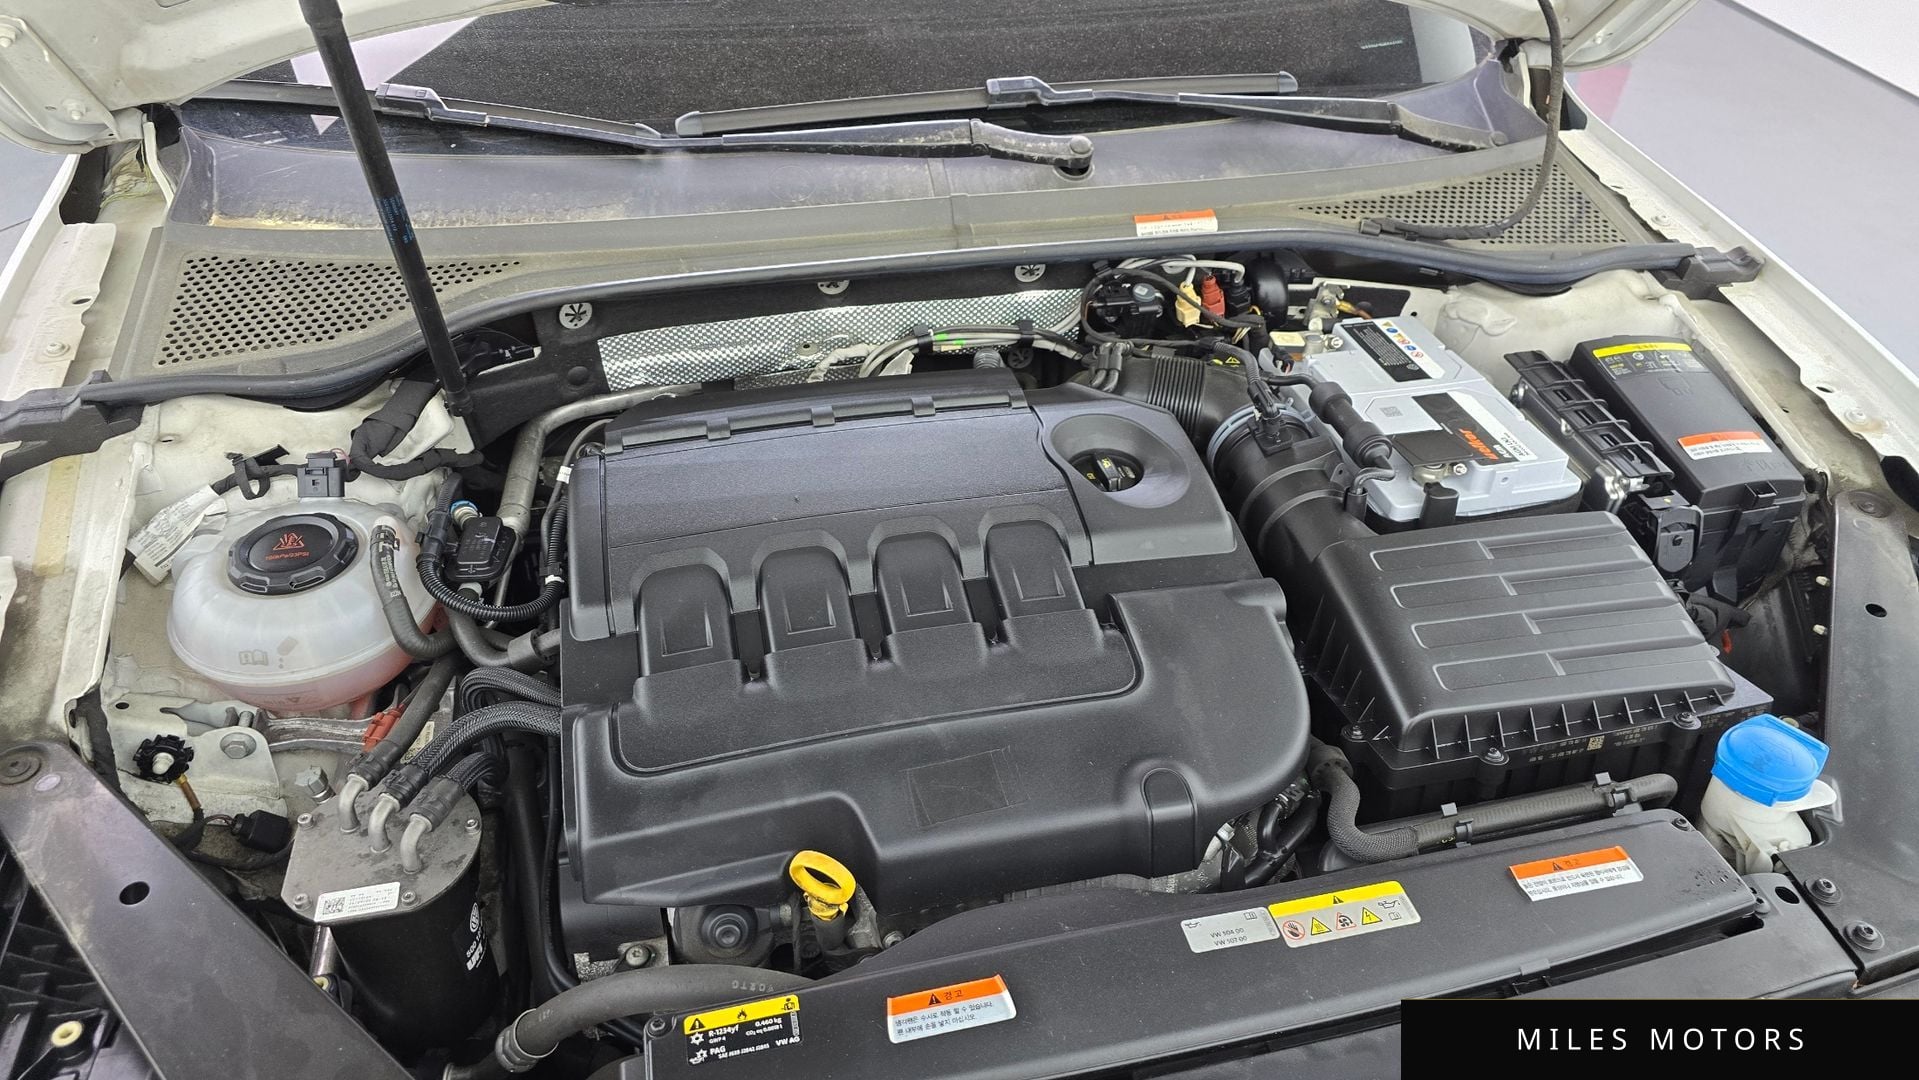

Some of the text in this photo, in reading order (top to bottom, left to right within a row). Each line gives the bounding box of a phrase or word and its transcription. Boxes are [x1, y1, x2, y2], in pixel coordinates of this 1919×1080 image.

[754, 1017, 782, 1027] 0.460 kg
[708, 1024, 739, 1037] R-1234yf
[789, 1035, 801, 1045] AG
[709, 1045, 726, 1055] PAG
